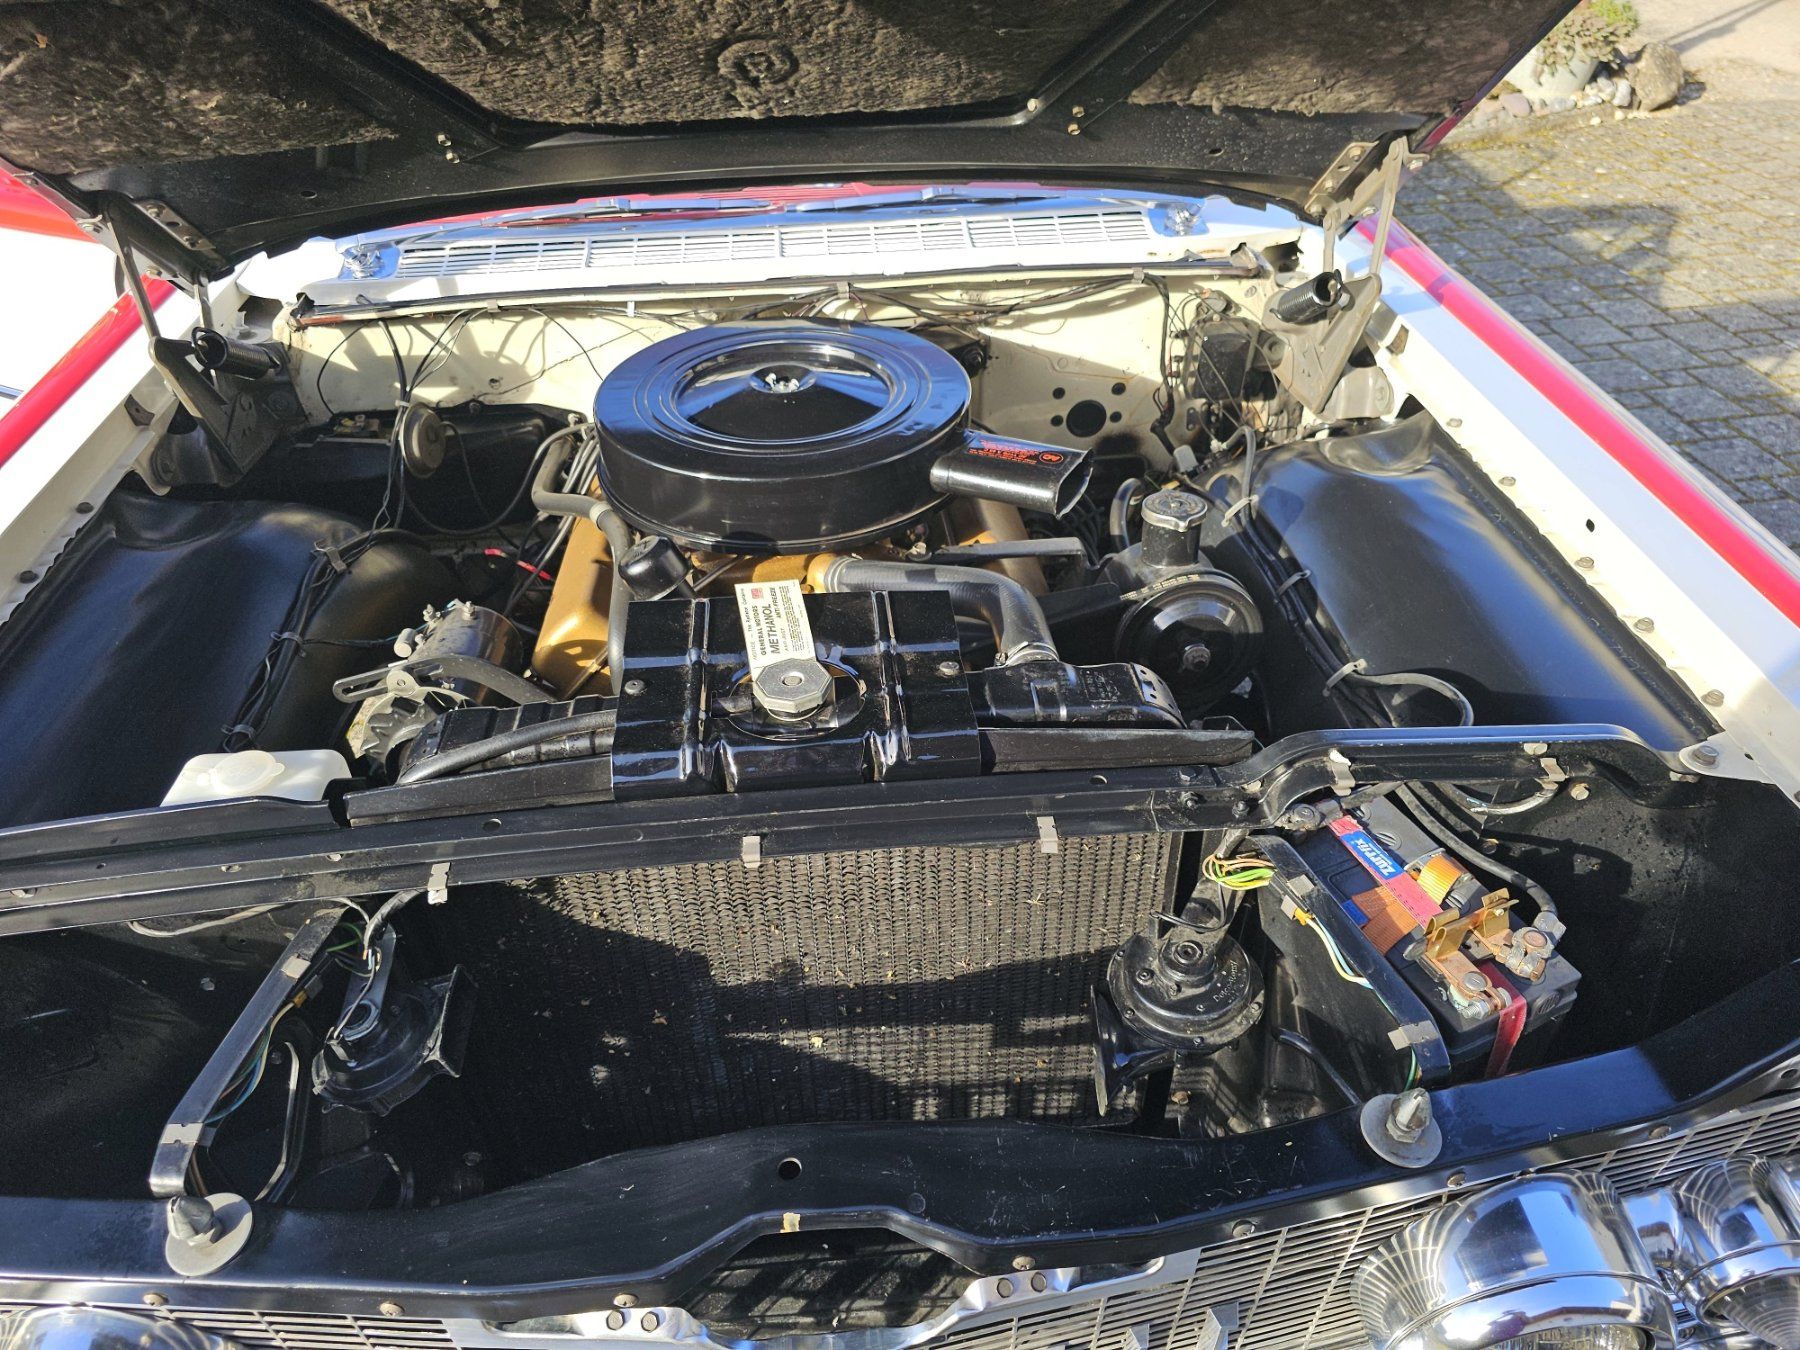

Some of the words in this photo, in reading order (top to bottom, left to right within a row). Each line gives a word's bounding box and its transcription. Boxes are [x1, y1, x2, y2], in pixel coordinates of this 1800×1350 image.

[752, 605, 761, 627] MOTORS
[762, 604, 781, 654] METHANOL
[757, 627, 767, 656] GENERAL
